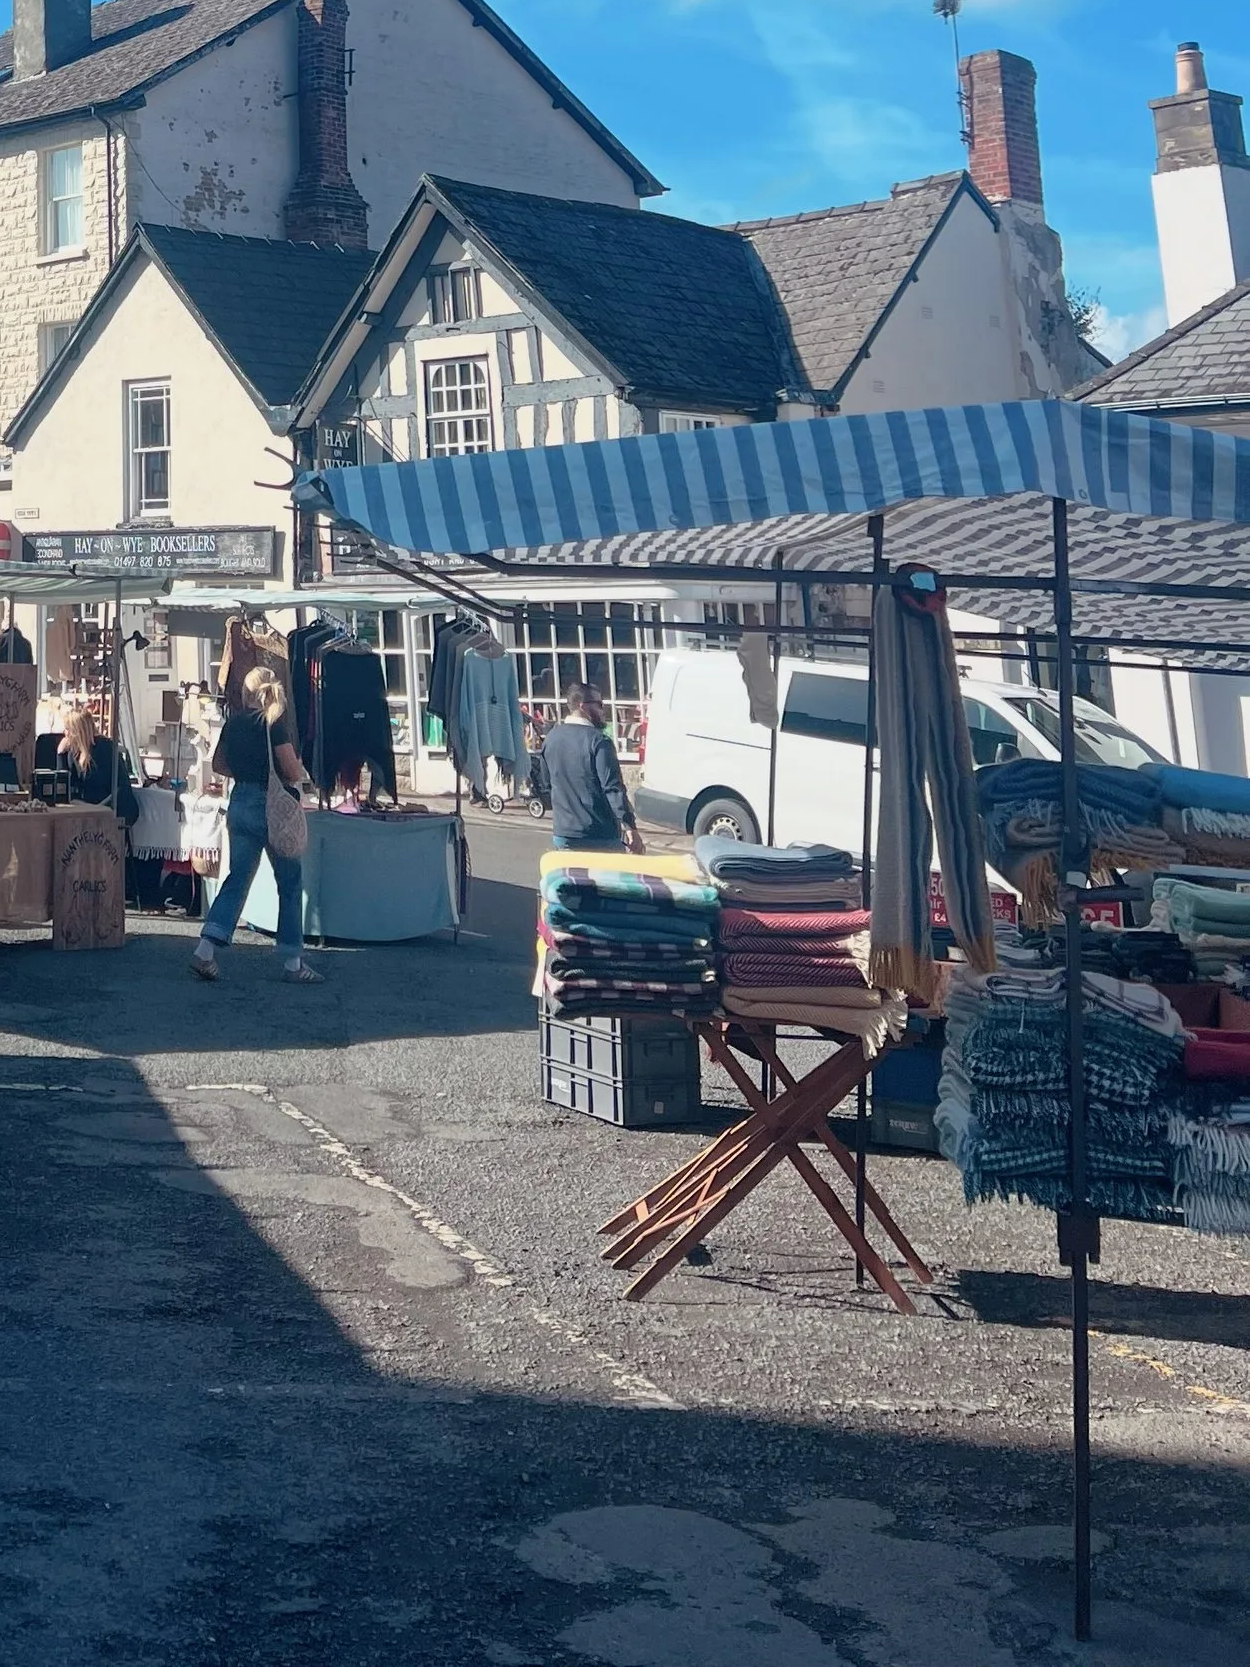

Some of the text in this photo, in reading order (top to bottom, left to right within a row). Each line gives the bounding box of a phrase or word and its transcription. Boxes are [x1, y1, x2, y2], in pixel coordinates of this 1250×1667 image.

[324, 429, 350, 448] HAY
[150, 535, 216, 553] BOOKSELLERS
[113, 555, 137, 567] 01497
[139, 556, 154, 567] 820
[157, 555, 171, 567] 875
